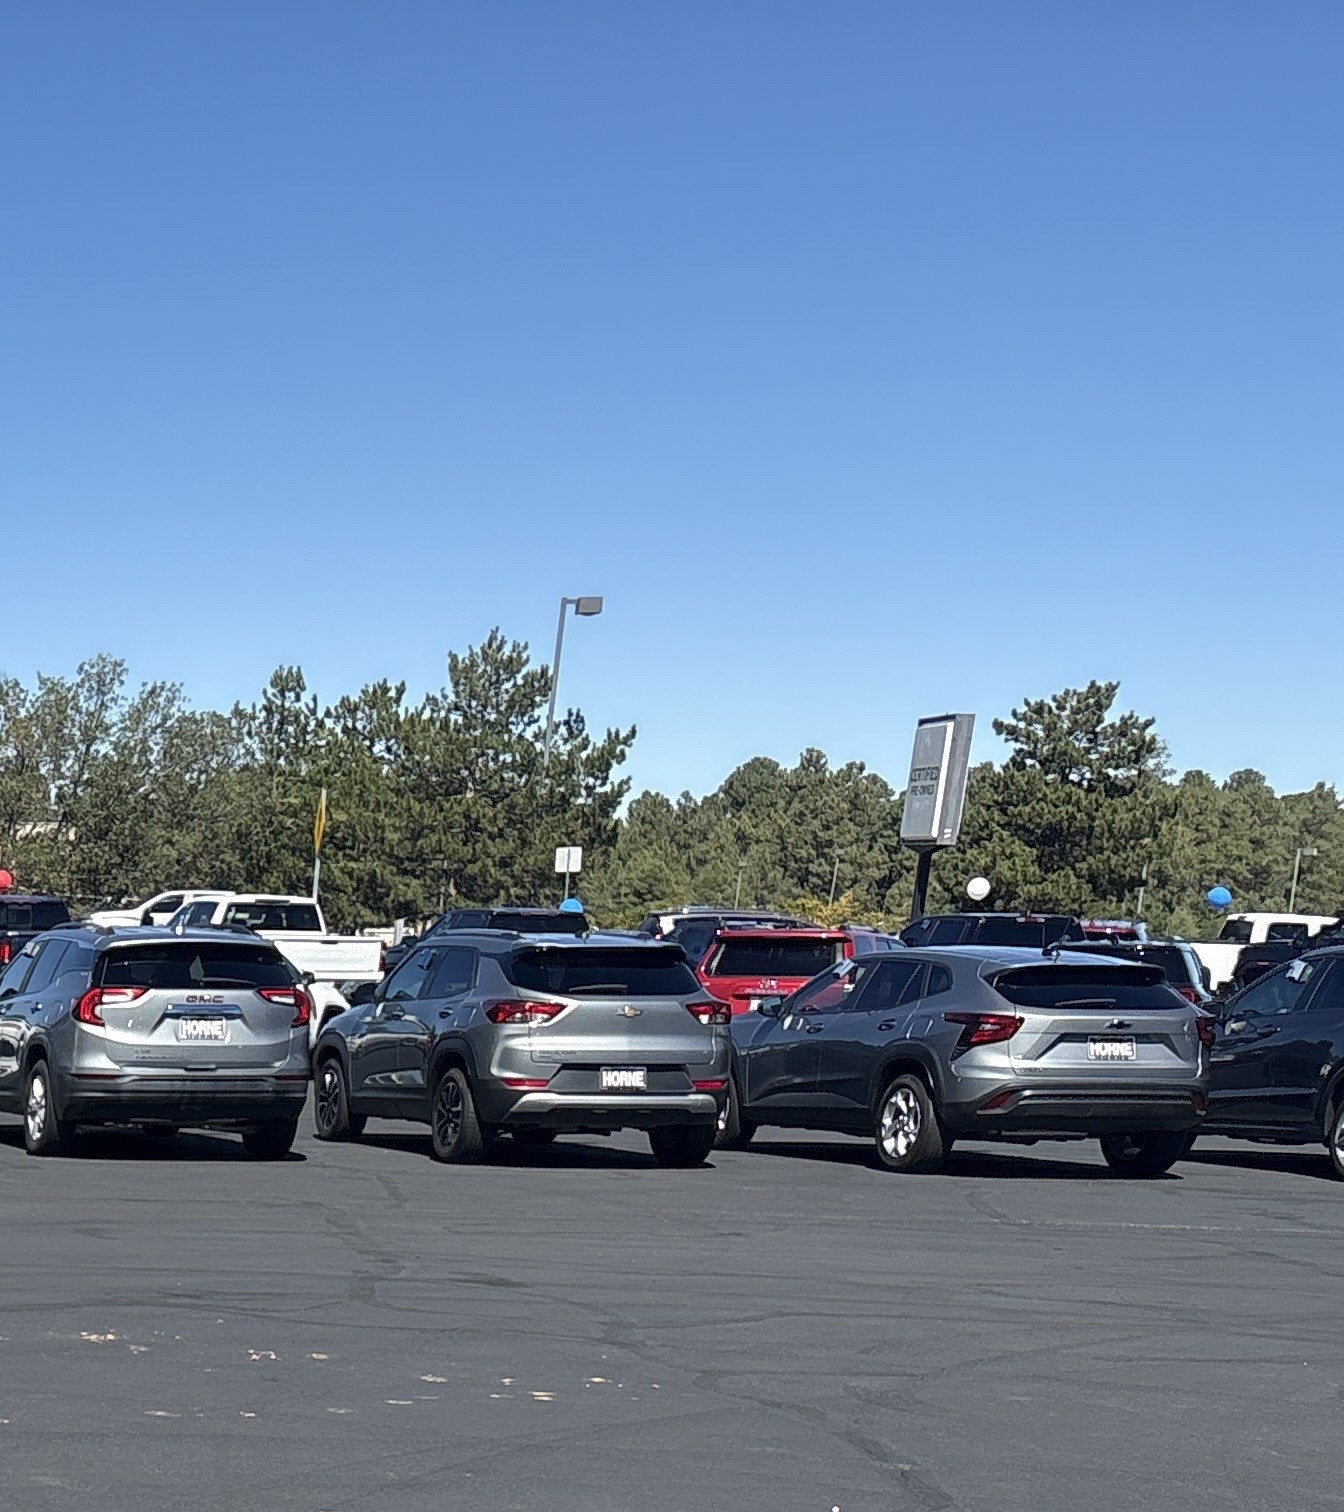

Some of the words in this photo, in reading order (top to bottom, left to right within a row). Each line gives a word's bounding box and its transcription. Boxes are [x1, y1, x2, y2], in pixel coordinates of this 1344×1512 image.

[185, 994, 224, 1004] GMC
[182, 1020, 224, 1036] HORNE
[1090, 1042, 1133, 1056] HORNE
[602, 1071, 645, 1087] HORNE
